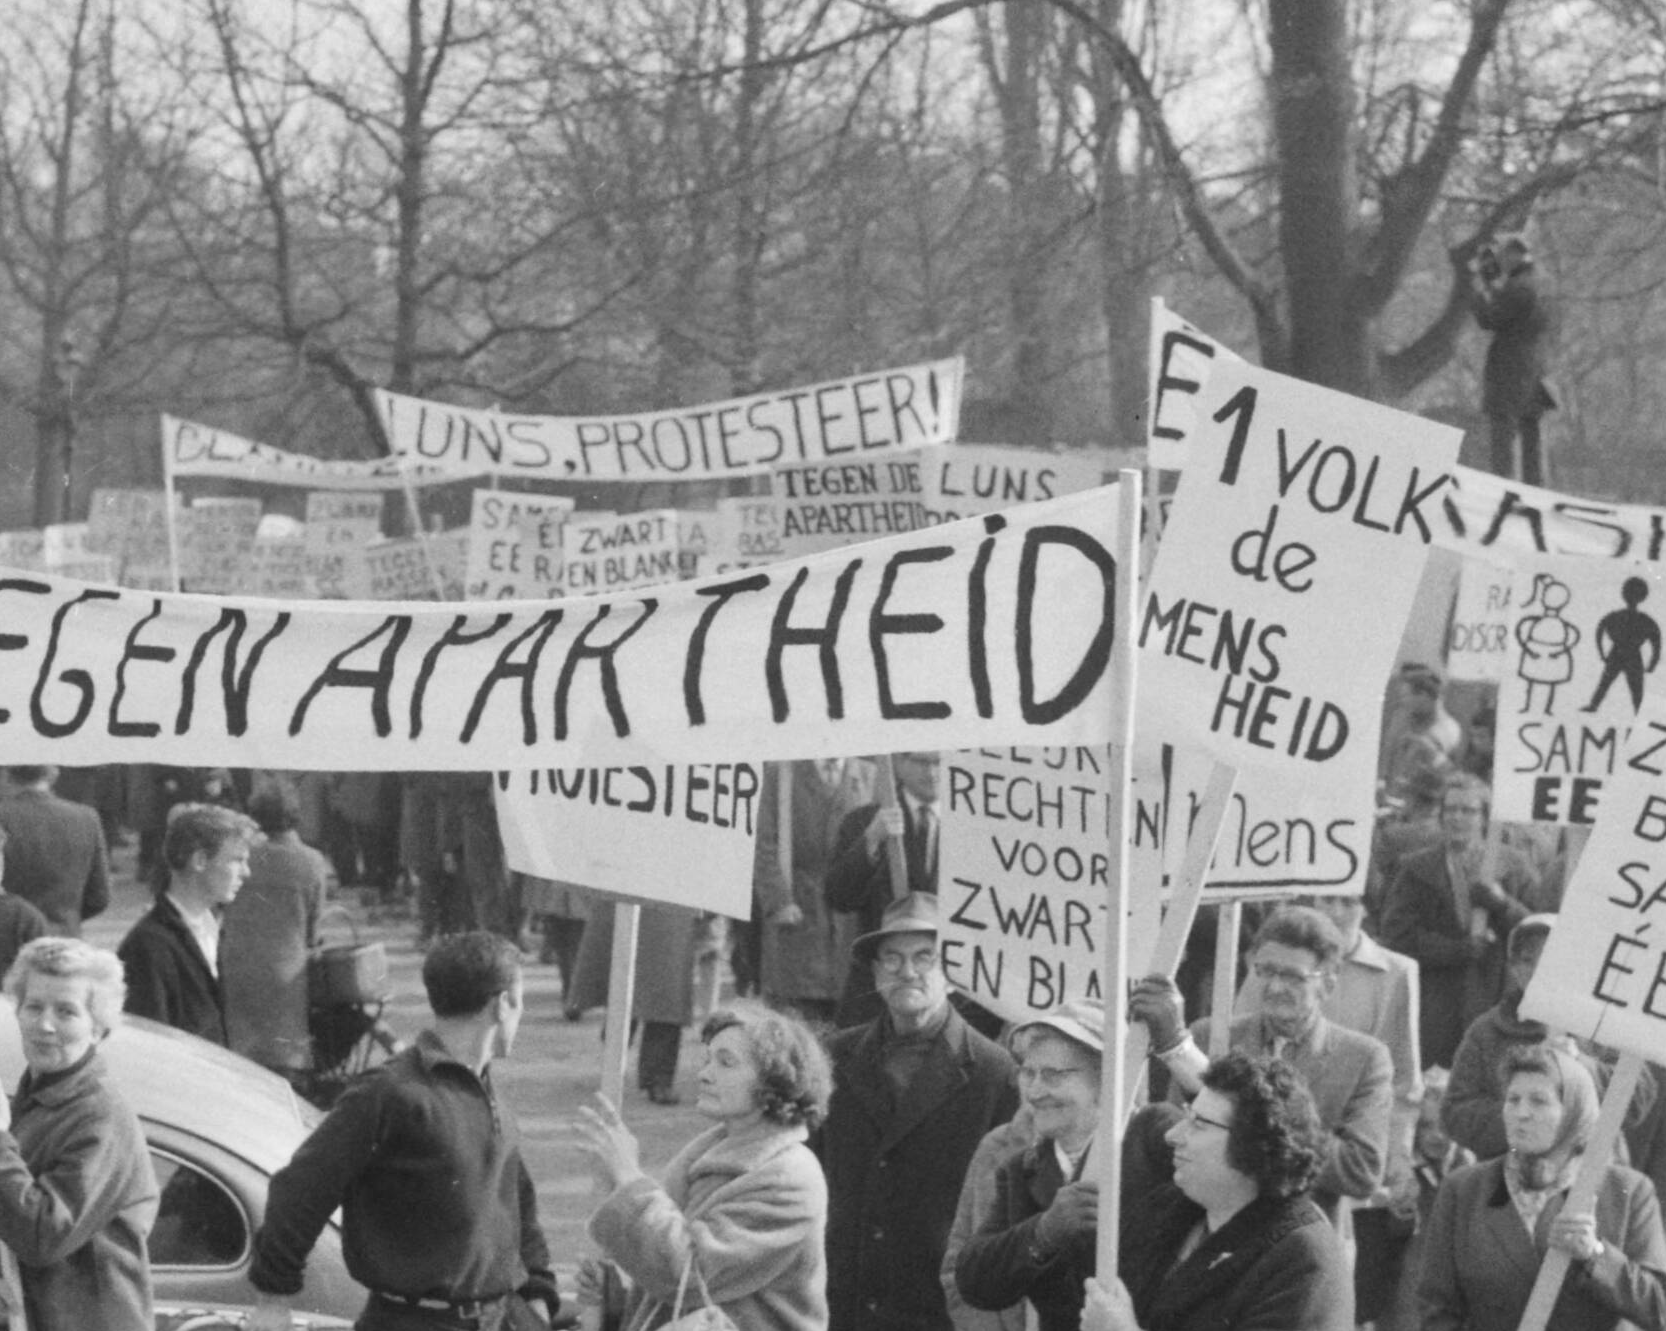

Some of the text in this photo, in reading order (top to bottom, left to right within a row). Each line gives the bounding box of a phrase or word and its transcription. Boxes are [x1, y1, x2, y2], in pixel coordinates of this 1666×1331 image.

[776, 461, 923, 498] TEGEN DE
[939, 462, 1055, 501] LUNS
[1212, 385, 1258, 486] 1
[1277, 428, 1450, 544] VOLK
[579, 517, 665, 554] ZWART
[1230, 504, 1318, 593] de
[568, 561, 597, 588] EN
[288, 514, 1116, 746] APARTHEID
[1137, 592, 1288, 683] MENS
[1450, 622, 1509, 653] DISCR
[1210, 672, 1349, 762] HEID
[1514, 722, 1632, 774] SAM
[991, 835, 1109, 887] VOOR
[941, 939, 1004, 999] EN
